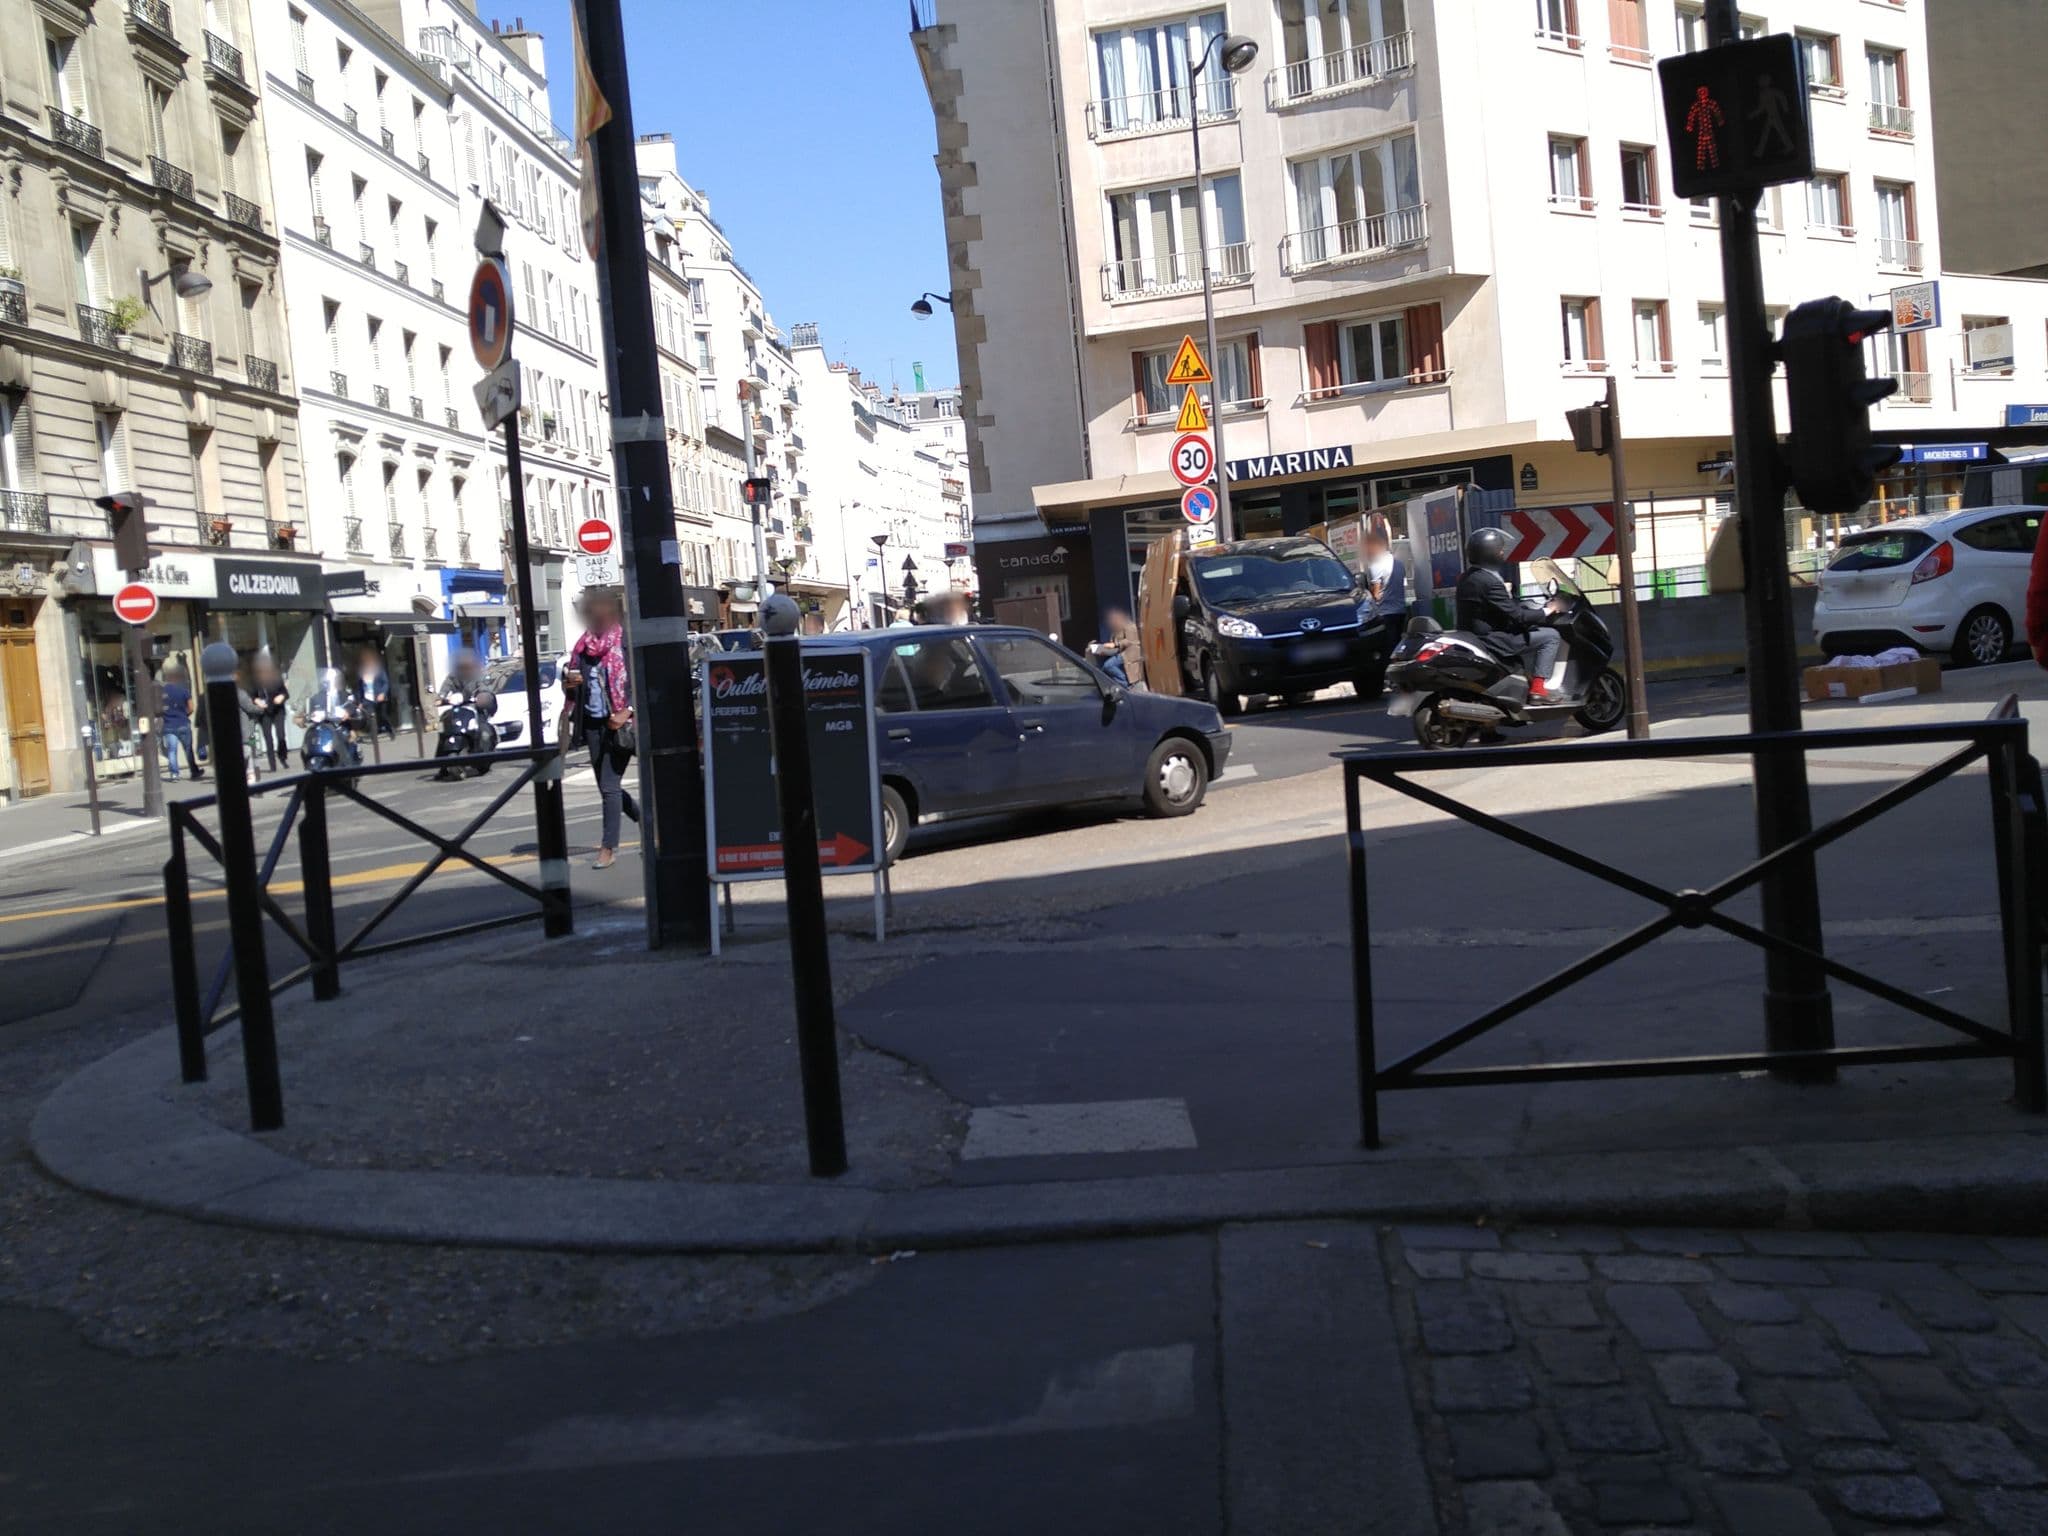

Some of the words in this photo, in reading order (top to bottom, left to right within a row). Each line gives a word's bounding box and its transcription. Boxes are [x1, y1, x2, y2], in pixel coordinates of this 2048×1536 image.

[1919, 301, 1931, 311] 15
[1180, 448, 1206, 471] 30
[1247, 447, 1349, 479] MARINA
[585, 557, 608, 567] SAUF
[229, 574, 300, 595] CALZEDONIA
[825, 720, 853, 732] MGB
